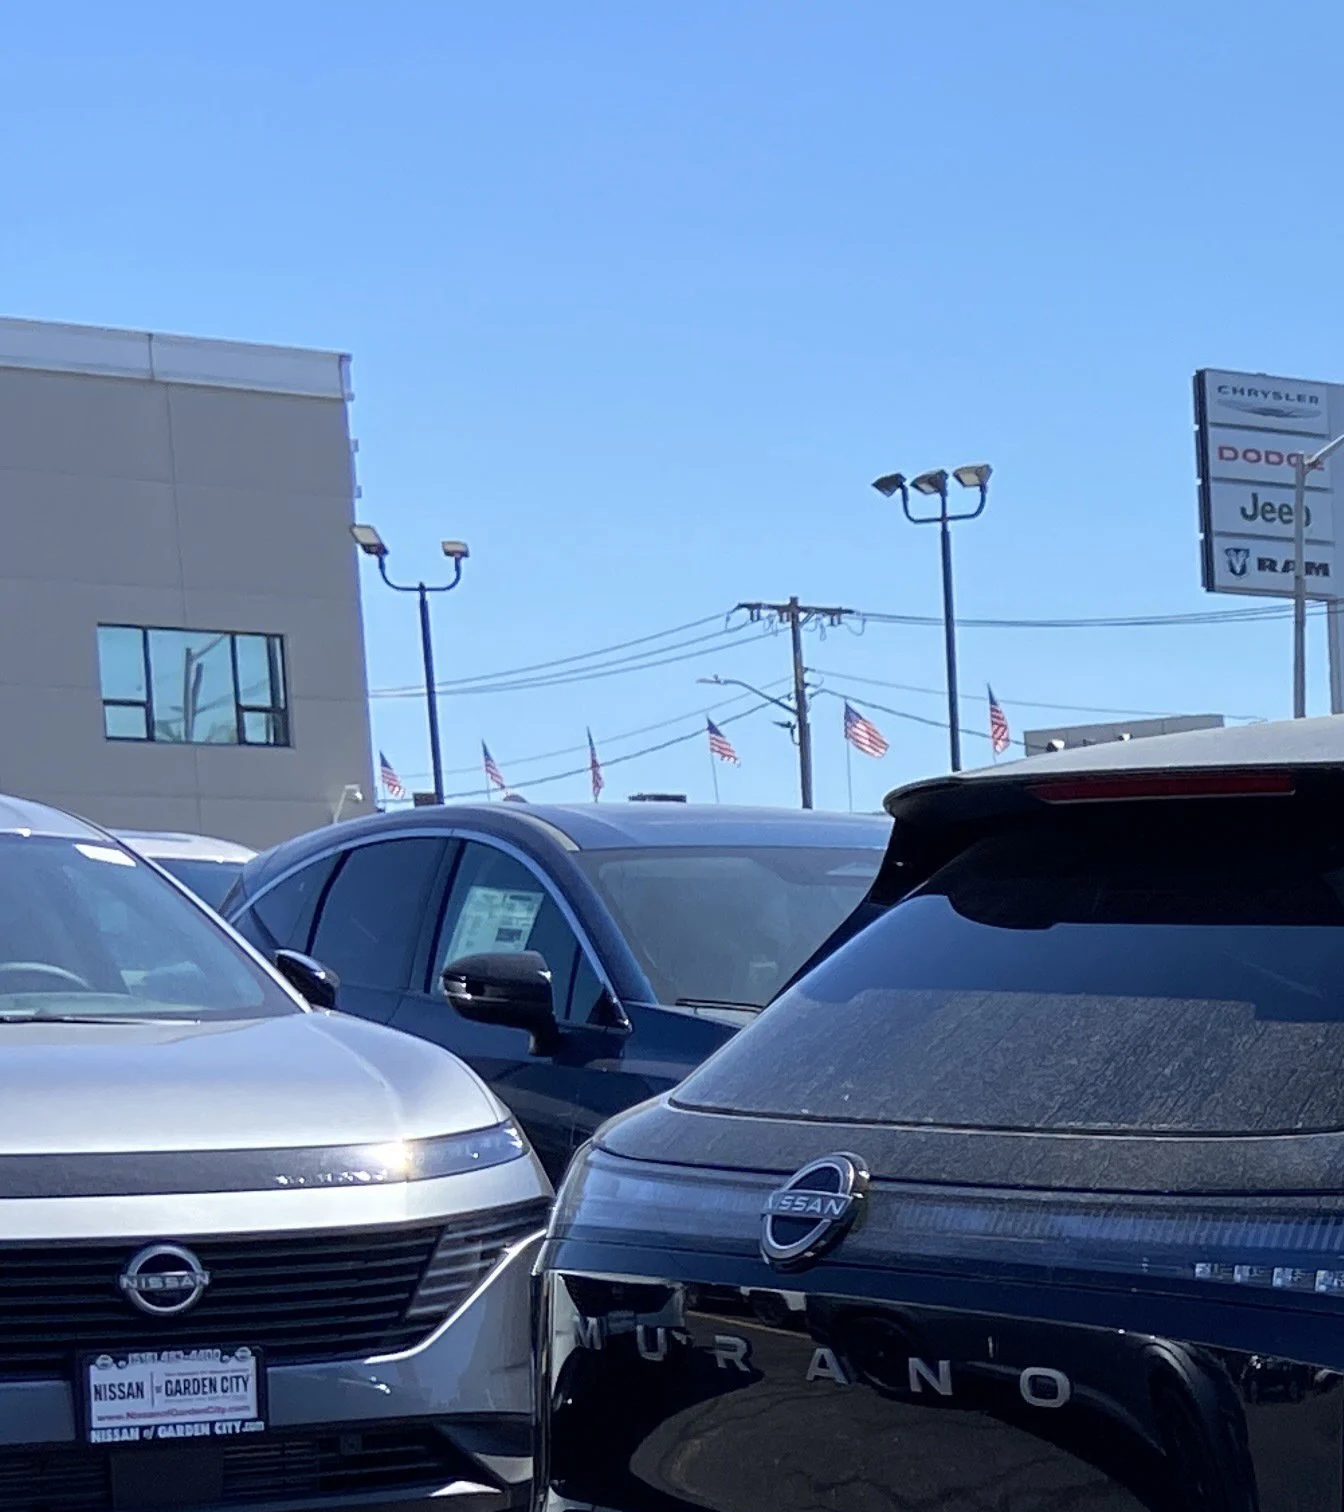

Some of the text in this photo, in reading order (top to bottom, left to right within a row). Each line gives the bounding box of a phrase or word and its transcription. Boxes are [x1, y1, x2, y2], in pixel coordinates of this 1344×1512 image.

[1217, 384, 1319, 405] CHRYSLER
[1217, 445, 1326, 471] DODG
[121, 1272, 210, 1290] NISSAN
[572, 1315, 1073, 1408] MURANO
[93, 1380, 145, 1402] NISSAN
[165, 1376, 217, 1397] GARDEN
[221, 1374, 250, 1395] CITY
[91, 1426, 140, 1443] NISSAN
[157, 1422, 210, 1439] GARDEN
